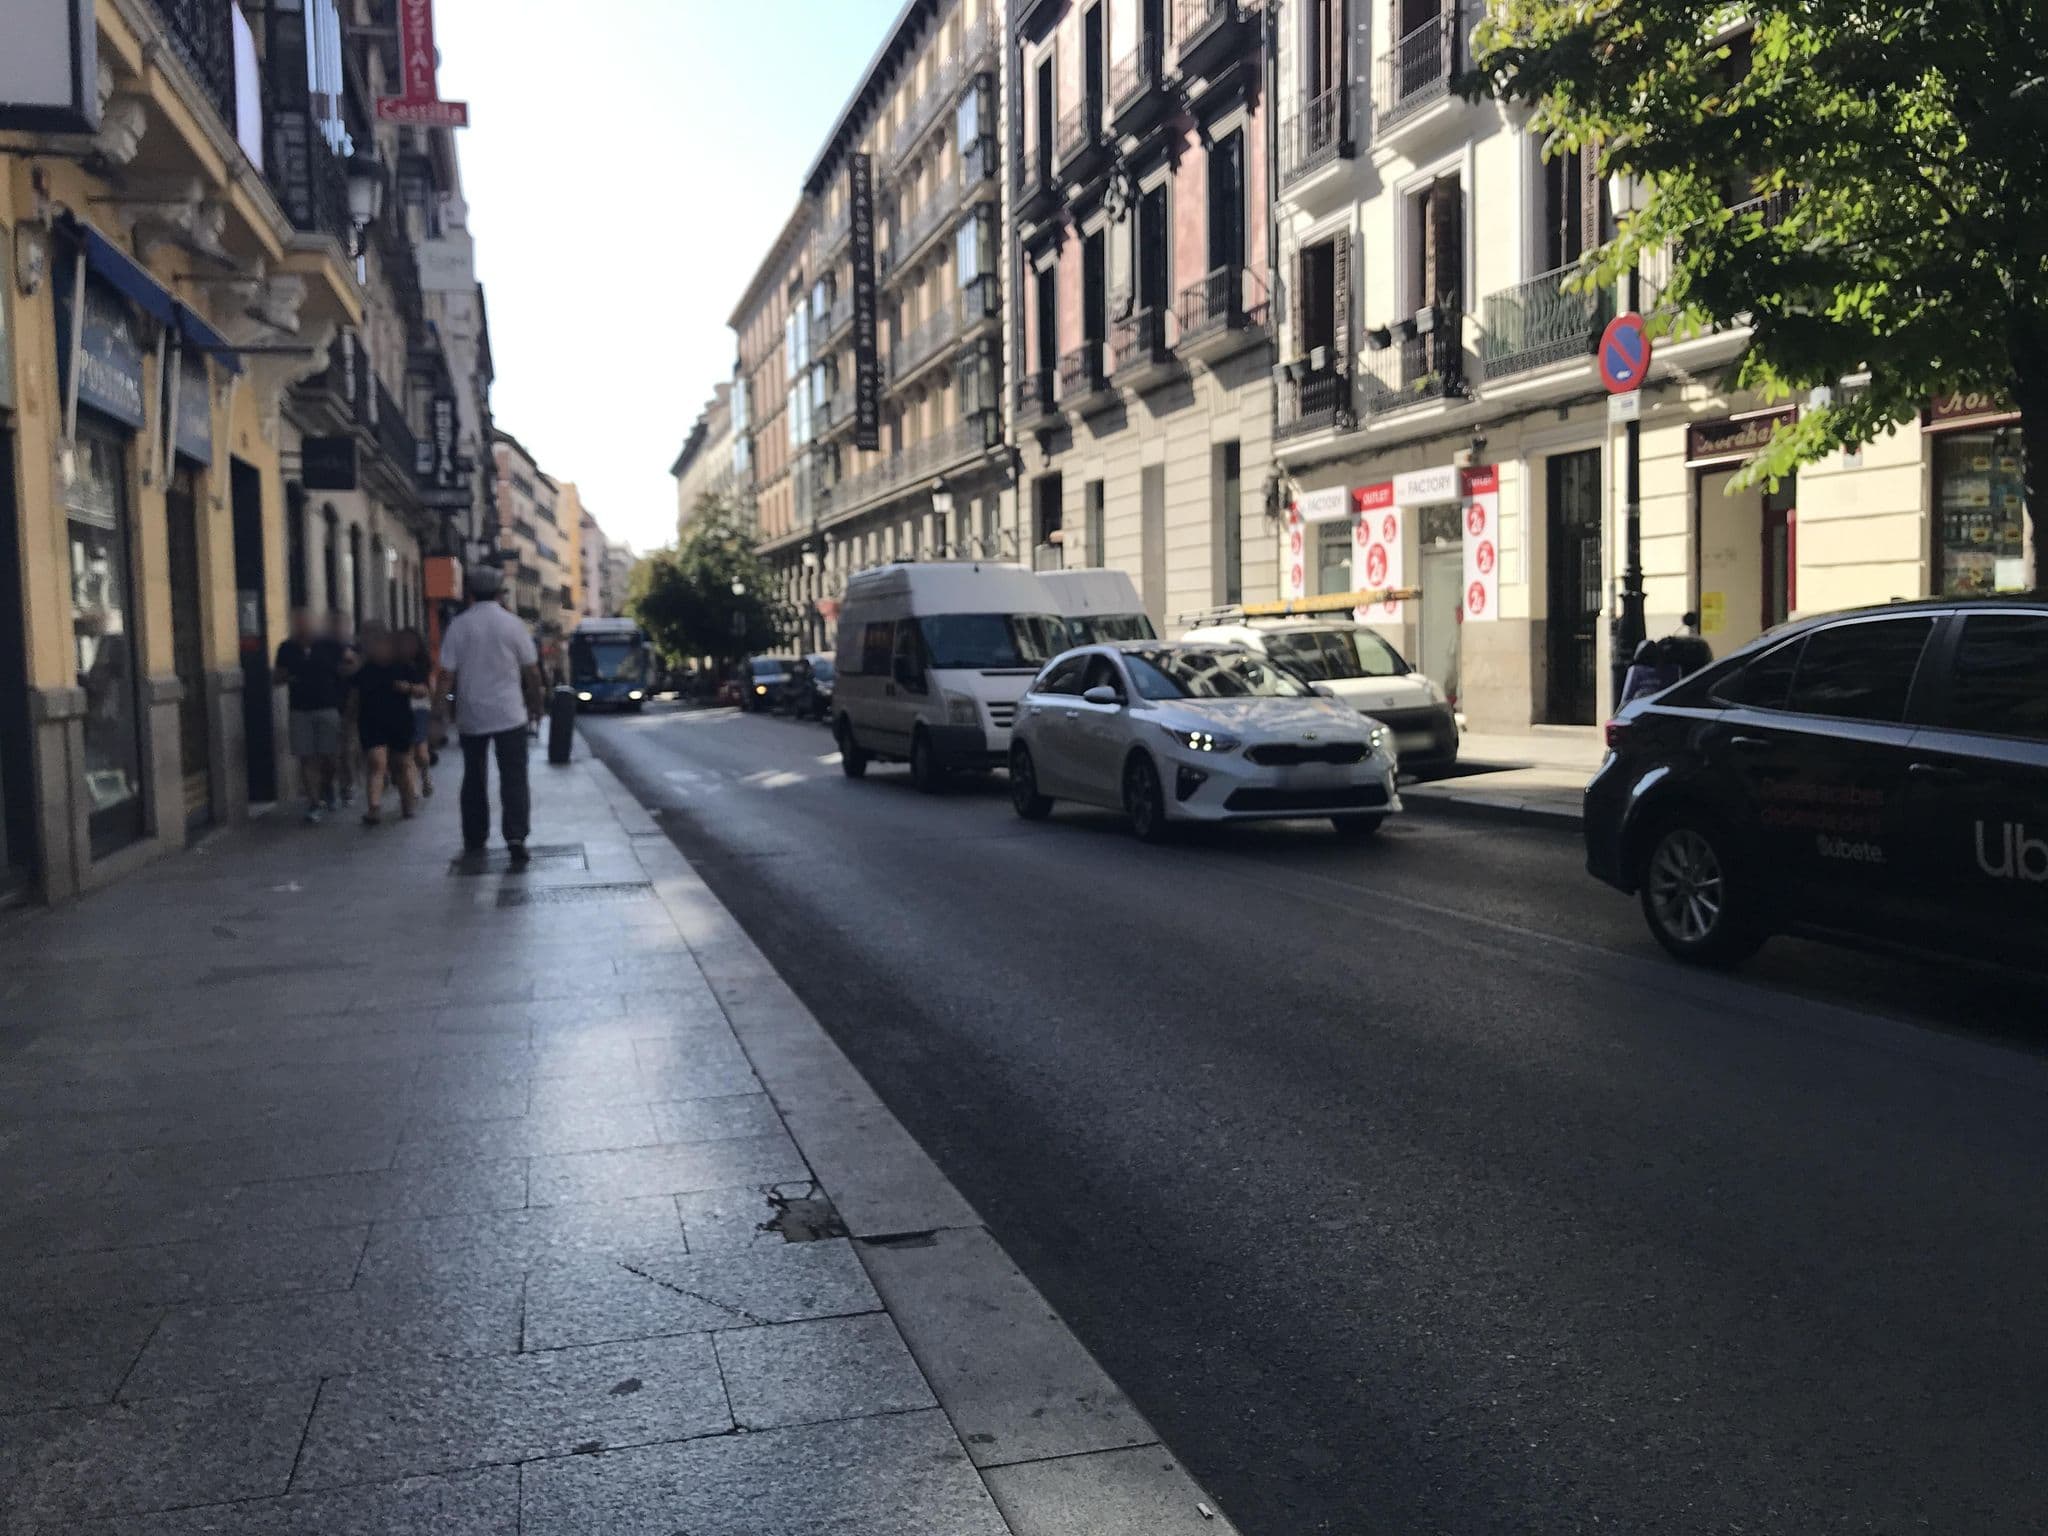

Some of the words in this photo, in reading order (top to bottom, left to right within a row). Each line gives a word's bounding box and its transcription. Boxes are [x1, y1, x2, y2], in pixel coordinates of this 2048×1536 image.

[435, 400, 453, 487] HOSTAL
[1407, 475, 1450, 494] FACTORY
[1975, 820, 2048, 881] Ub
